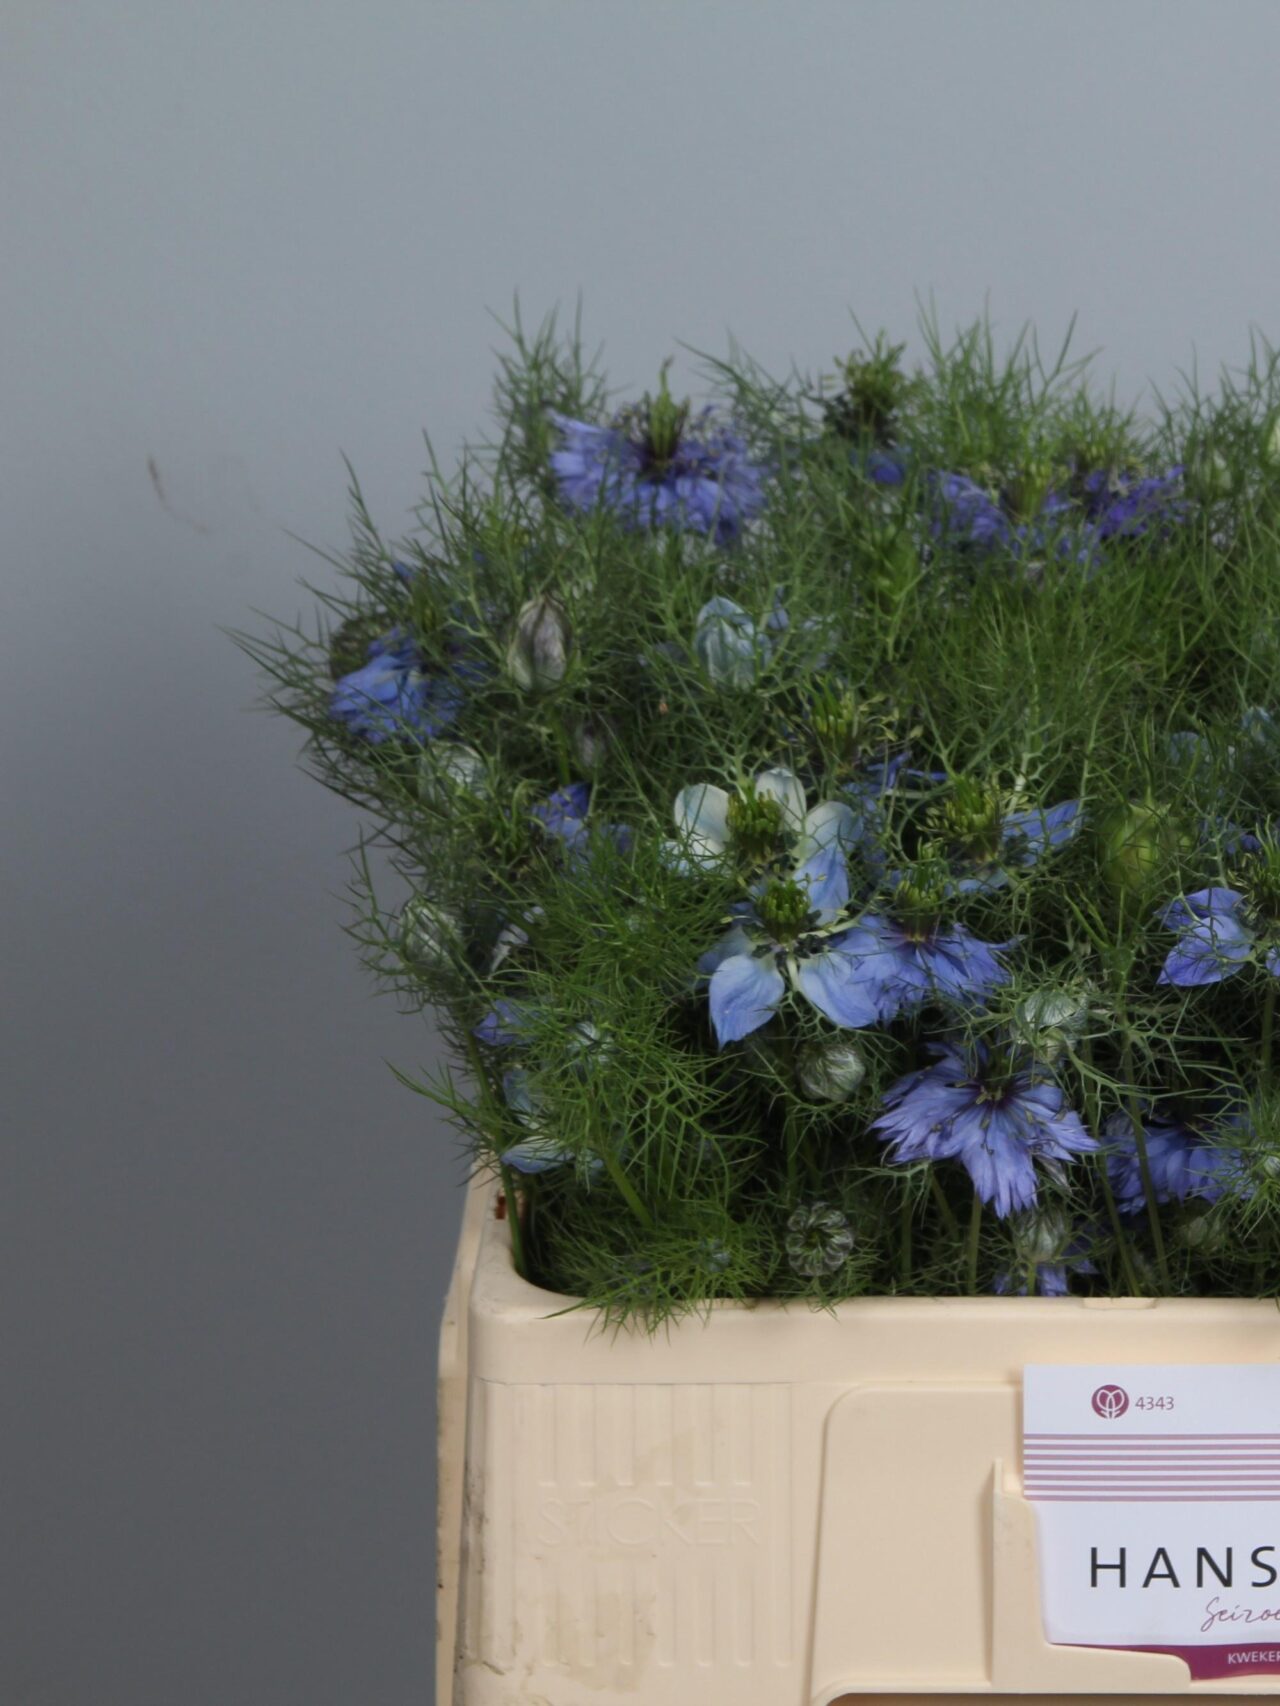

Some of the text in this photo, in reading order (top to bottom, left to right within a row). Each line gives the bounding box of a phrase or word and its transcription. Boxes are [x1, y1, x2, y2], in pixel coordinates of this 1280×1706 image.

[1135, 1396, 1175, 1411] 4343
[537, 1496, 762, 1547] STICKER
[1090, 1545, 1278, 1589] HANS
